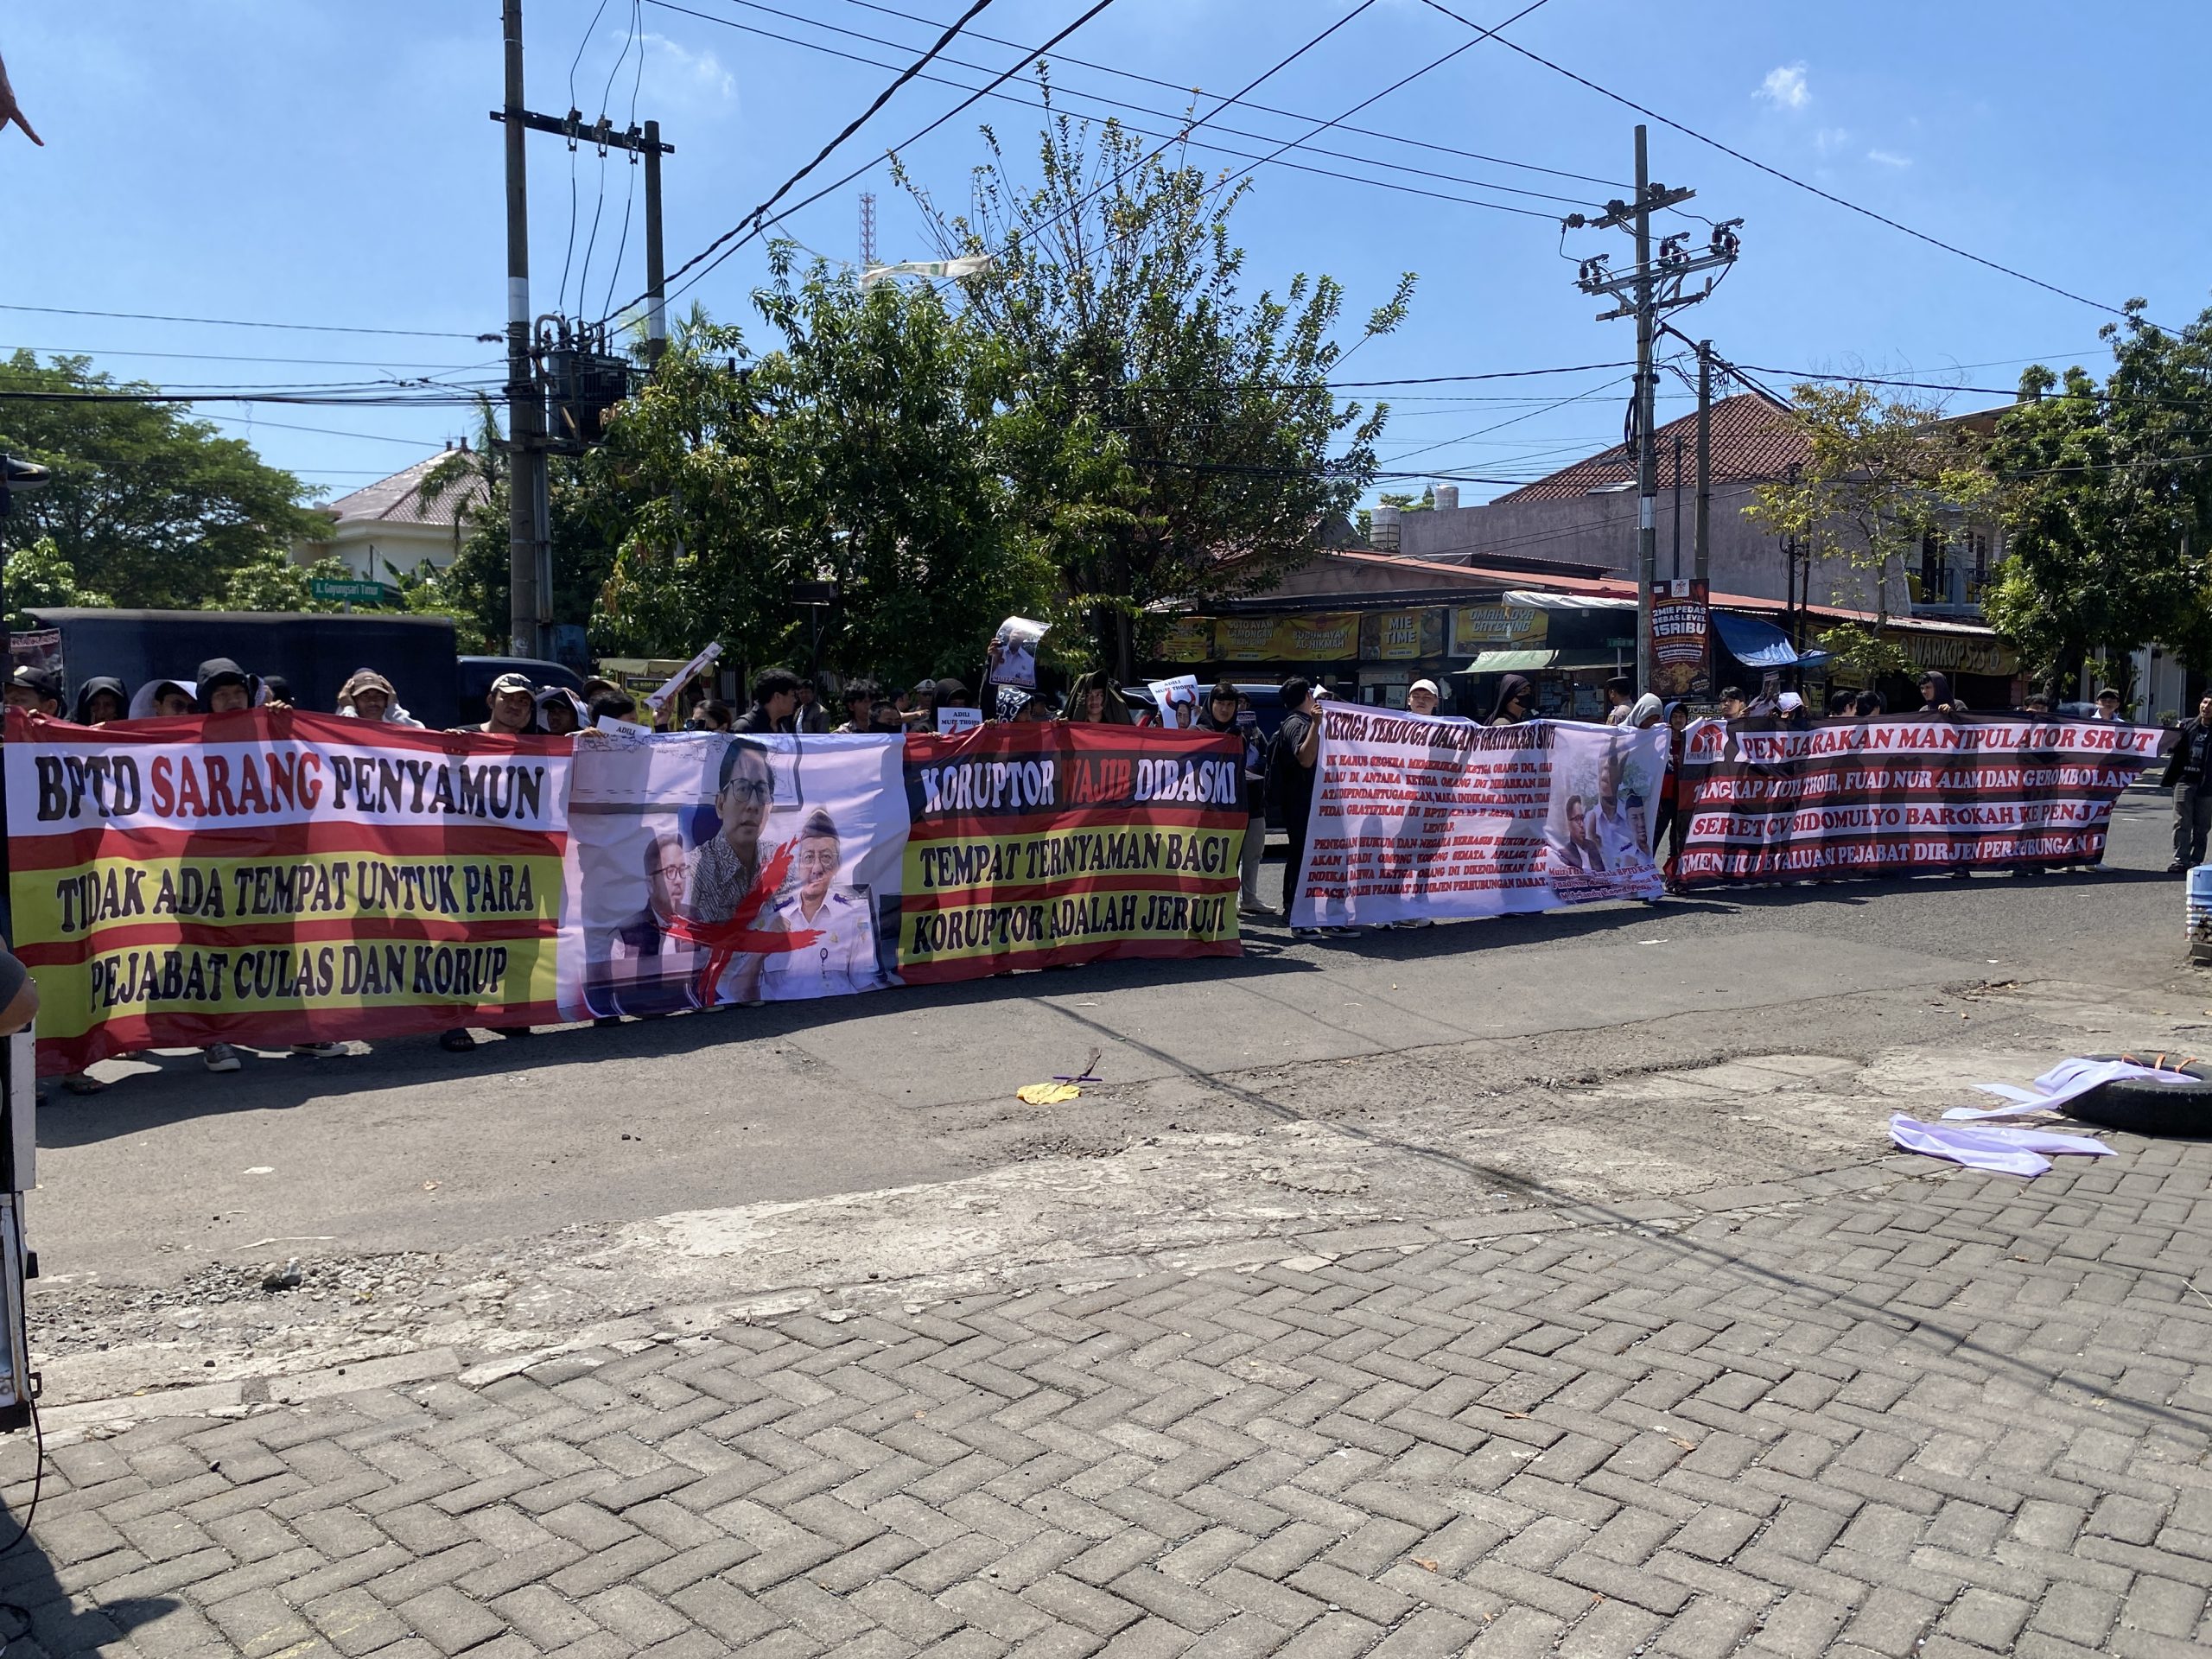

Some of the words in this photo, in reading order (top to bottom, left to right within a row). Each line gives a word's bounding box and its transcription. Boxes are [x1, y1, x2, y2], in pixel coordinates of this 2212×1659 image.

[1676, 606, 1707, 614] PEDAS
[1250, 620, 1274, 629] AYAM
[1389, 616, 1413, 630] MIE
[1652, 614, 1681, 624] BEBAS
[1228, 630, 1274, 639] LAMONGAN
[1323, 629, 1349, 639] AYAM
[1384, 632, 1417, 644] TIME
[1295, 639, 1345, 649] AL-HIKMAH
[1912, 637, 1964, 667] WARKOP
[616, 726, 636, 734] ADILI
[1325, 710, 1370, 742] KETIGA
[1369, 717, 1434, 747] TERDUGA
[1742, 728, 1894, 760] PENJARAKAN
[1897, 728, 2077, 749] MANIPULATOR
[2081, 729, 2155, 752] SRUT
[1339, 755, 1368, 767] HARUS
[1370, 756, 1406, 768] SEGERA
[1493, 763, 1519, 773] ORANG
[35, 755, 141, 822] BPTD
[151, 753, 323, 818] SARANG
[332, 755, 544, 820] PENYAMUN
[920, 760, 1055, 813] KORUPTOR
[1134, 758, 1237, 804] DIBASMI
[1349, 772, 1361, 783] DI
[1362, 772, 1402, 784] ANTARA
[1406, 774, 1438, 787] KETIGA
[1441, 778, 1471, 788] ORANG
[1693, 779, 1764, 803] TANGKAP
[1845, 771, 1891, 790] FUAD
[1893, 770, 1932, 789] NUR
[1936, 770, 1982, 789] ALAM
[1985, 768, 2020, 788] DAN
[1495, 793, 1534, 804] ADANYA
[1408, 806, 1421, 817] DI
[1693, 817, 1765, 837] SERET
[1767, 817, 1792, 836] CV
[1792, 809, 1900, 833] SIDOMULYO
[1905, 806, 2015, 826] BAROKAH
[2018, 805, 2038, 823] KE
[1359, 837, 1395, 849] HUKUM
[1395, 838, 1418, 849] DAN
[1494, 836, 1529, 847] HUKUM
[919, 843, 1020, 888] TEMPAT
[1026, 832, 1162, 878] TERNYAMAN
[1166, 834, 1230, 874] BAGI
[1311, 855, 1342, 866] AKAN
[1377, 854, 1412, 864] OMONG
[1531, 849, 1548, 858] ADA
[1762, 847, 1834, 873] EVALUASI
[1839, 842, 1910, 865] PEJABAT
[1914, 842, 1981, 861] DIRJEN
[1379, 868, 1414, 879] KETIGA
[1417, 867, 1445, 878] ORANG
[1448, 866, 1460, 876] INI
[1464, 863, 1525, 874] DIKENDALIKAN
[1528, 862, 1547, 873] DAN
[1453, 878, 1515, 891] PERHUBUNGAN
[56, 867, 147, 933] TIDAK
[153, 863, 226, 919] ADA
[234, 861, 351, 918] TEMPAT
[357, 861, 461, 914] UNTUK
[465, 864, 534, 913] PARA
[912, 905, 1043, 955] KORUPTOR
[1049, 895, 1138, 939] ADALAH
[1142, 895, 1227, 934] JERUJI
[90, 950, 229, 1014] PEJABAT
[234, 946, 334, 1000] CULAS
[340, 944, 408, 997] DAN
[413, 944, 508, 995] KORUP
